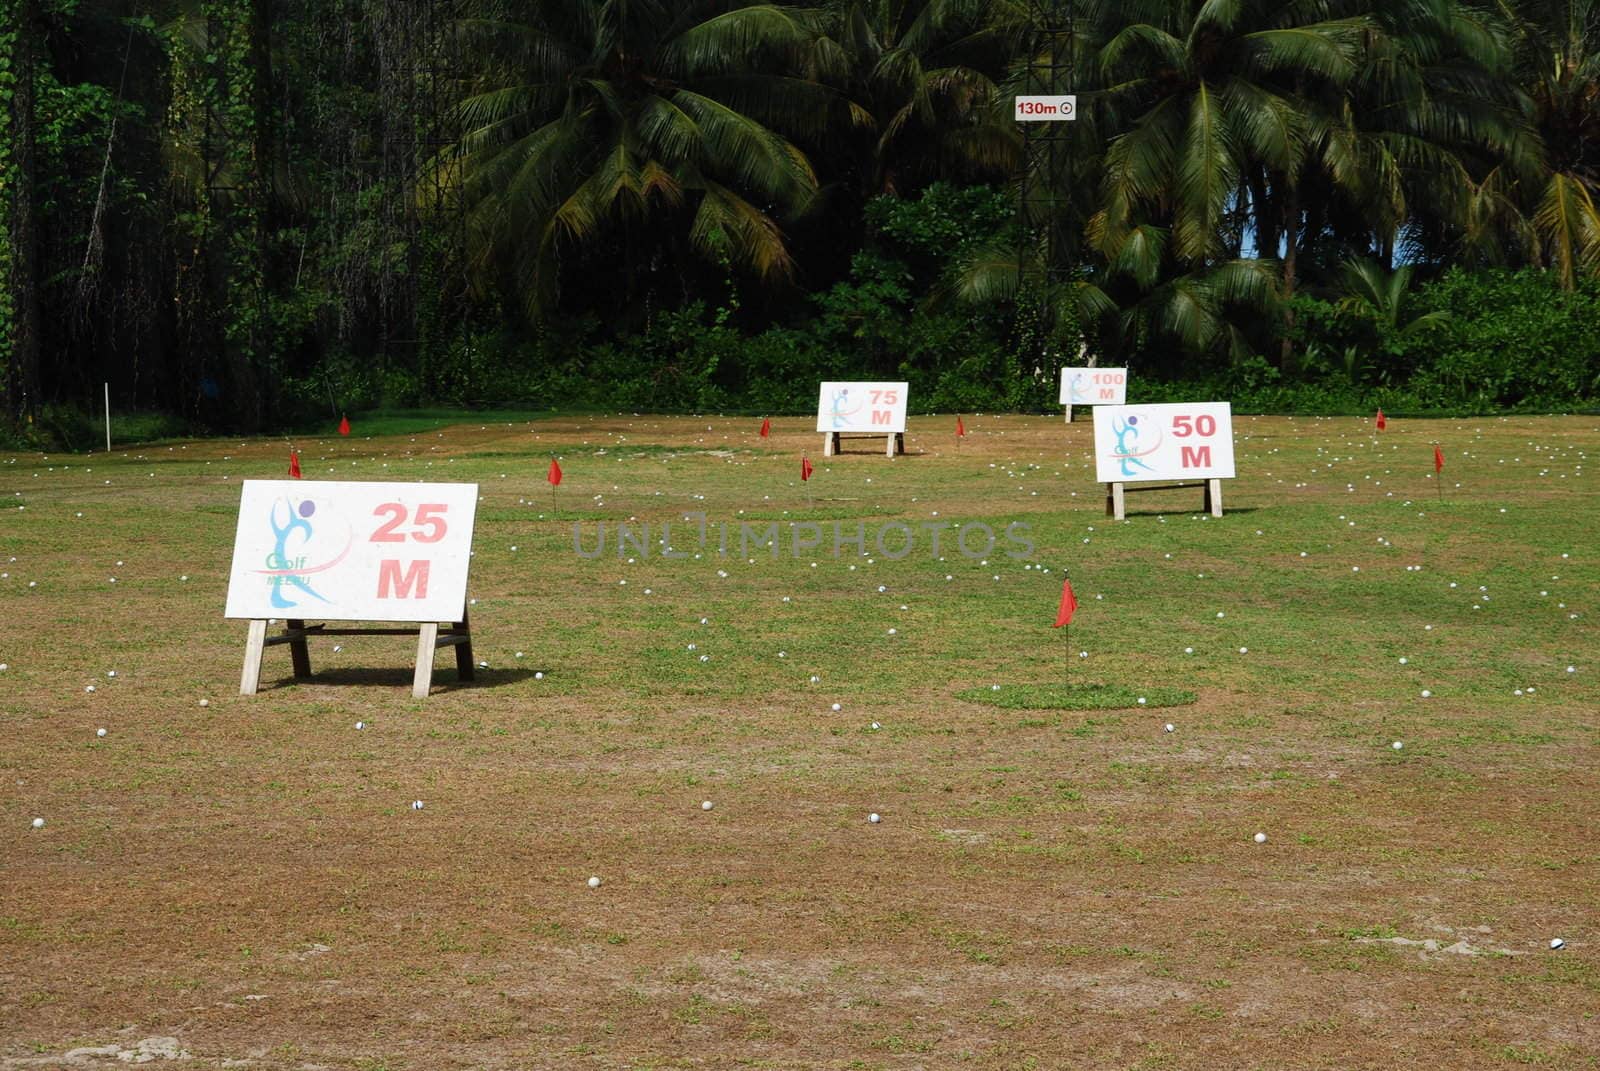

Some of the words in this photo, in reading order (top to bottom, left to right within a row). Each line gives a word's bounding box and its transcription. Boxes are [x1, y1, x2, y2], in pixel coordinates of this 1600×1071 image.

[1018, 102, 1057, 114] 130m
[1092, 374, 1124, 384] 100
[869, 390, 898, 405] 75
[1100, 388, 1115, 399] M
[871, 411, 891, 424] M
[1172, 415, 1216, 437] 50
[1181, 446, 1212, 468] M
[369, 503, 448, 543] 25
[265, 552, 307, 570] Golf
[377, 560, 430, 599] M
